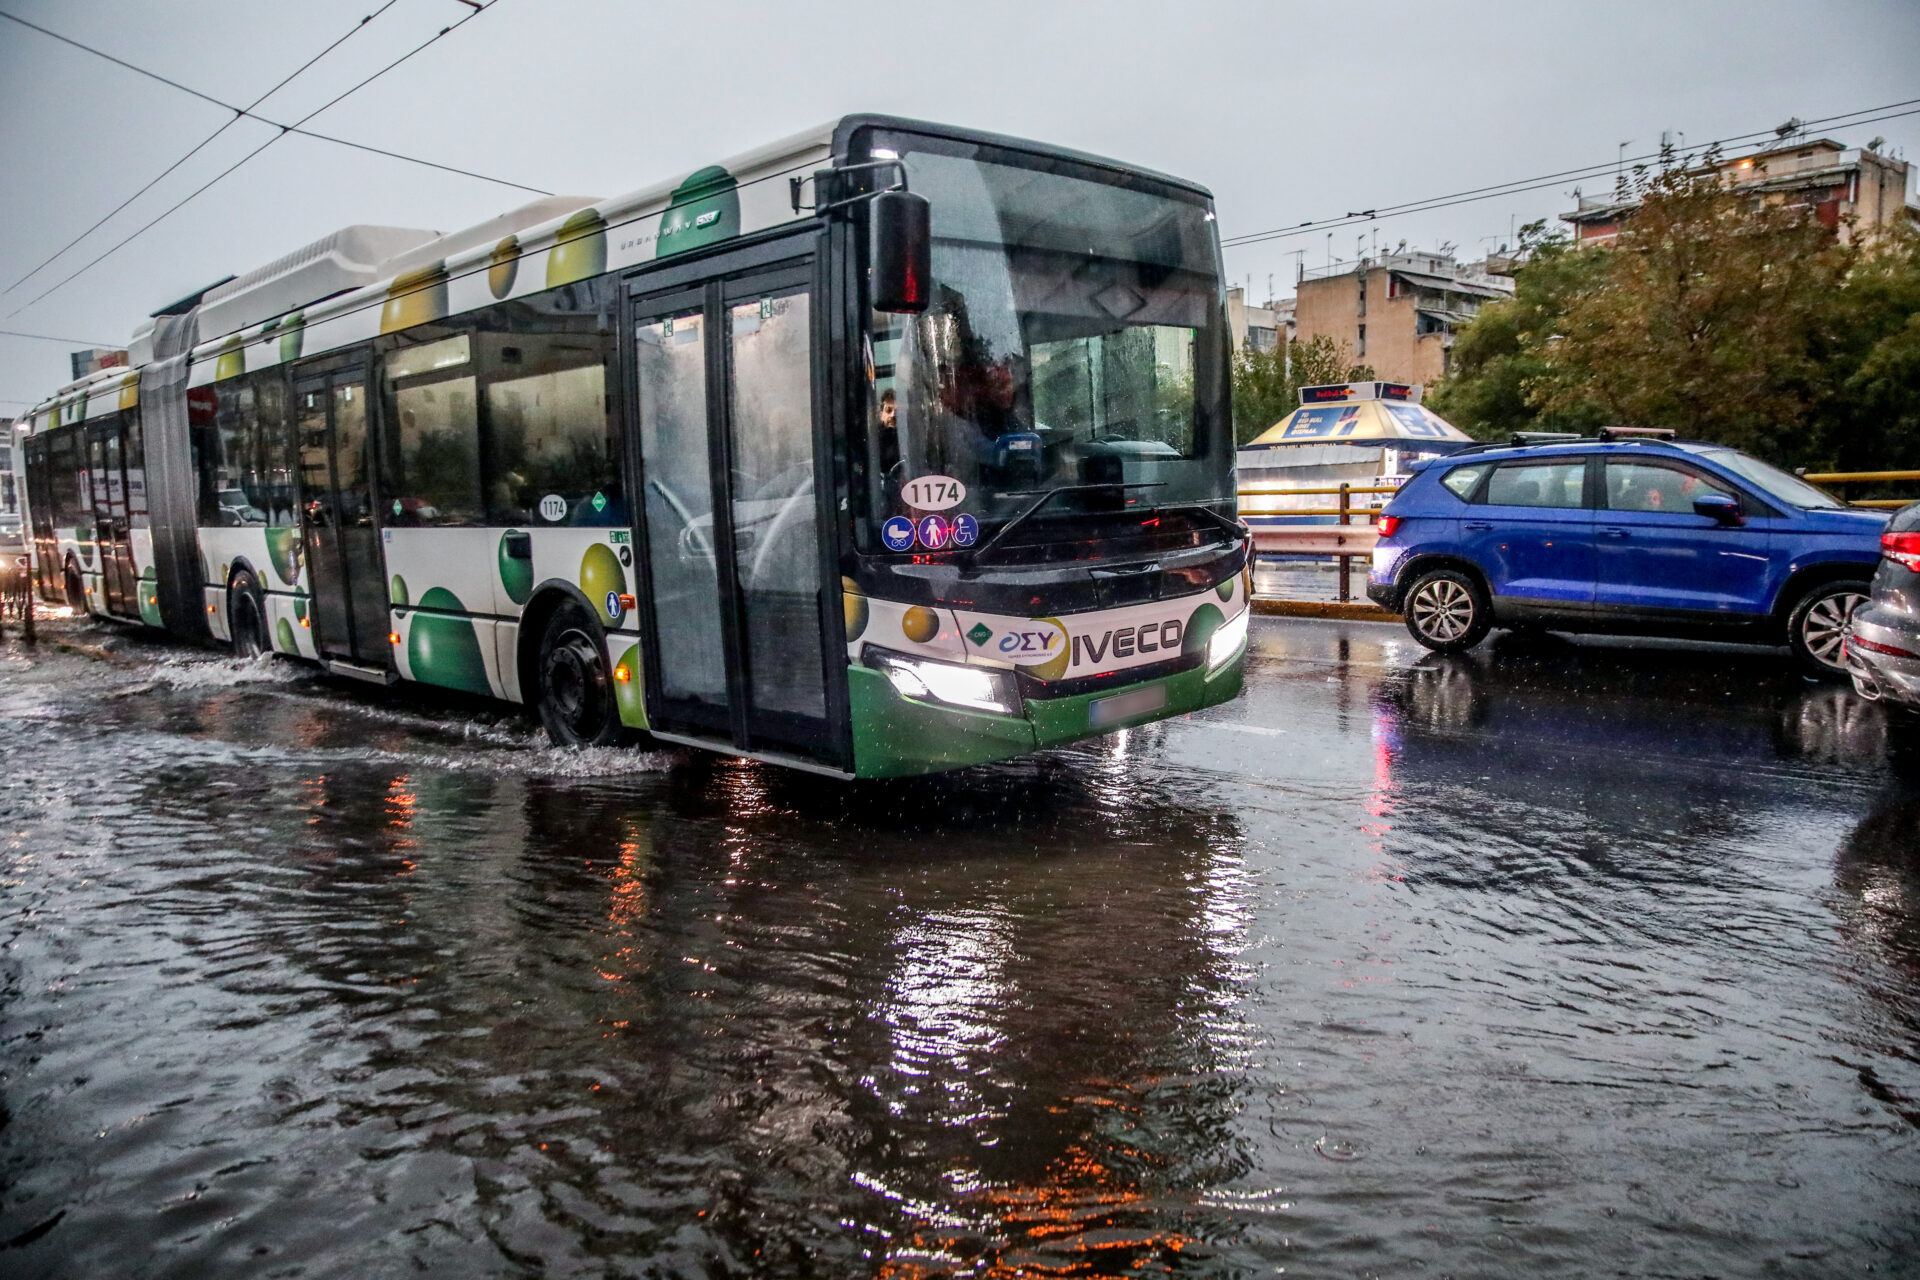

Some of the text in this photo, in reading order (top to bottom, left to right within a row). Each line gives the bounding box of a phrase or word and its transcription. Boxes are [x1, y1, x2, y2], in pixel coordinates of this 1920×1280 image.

[911, 482, 959, 503] 1174
[544, 501, 564, 516] 1174
[1072, 619, 1183, 667] IVECO
